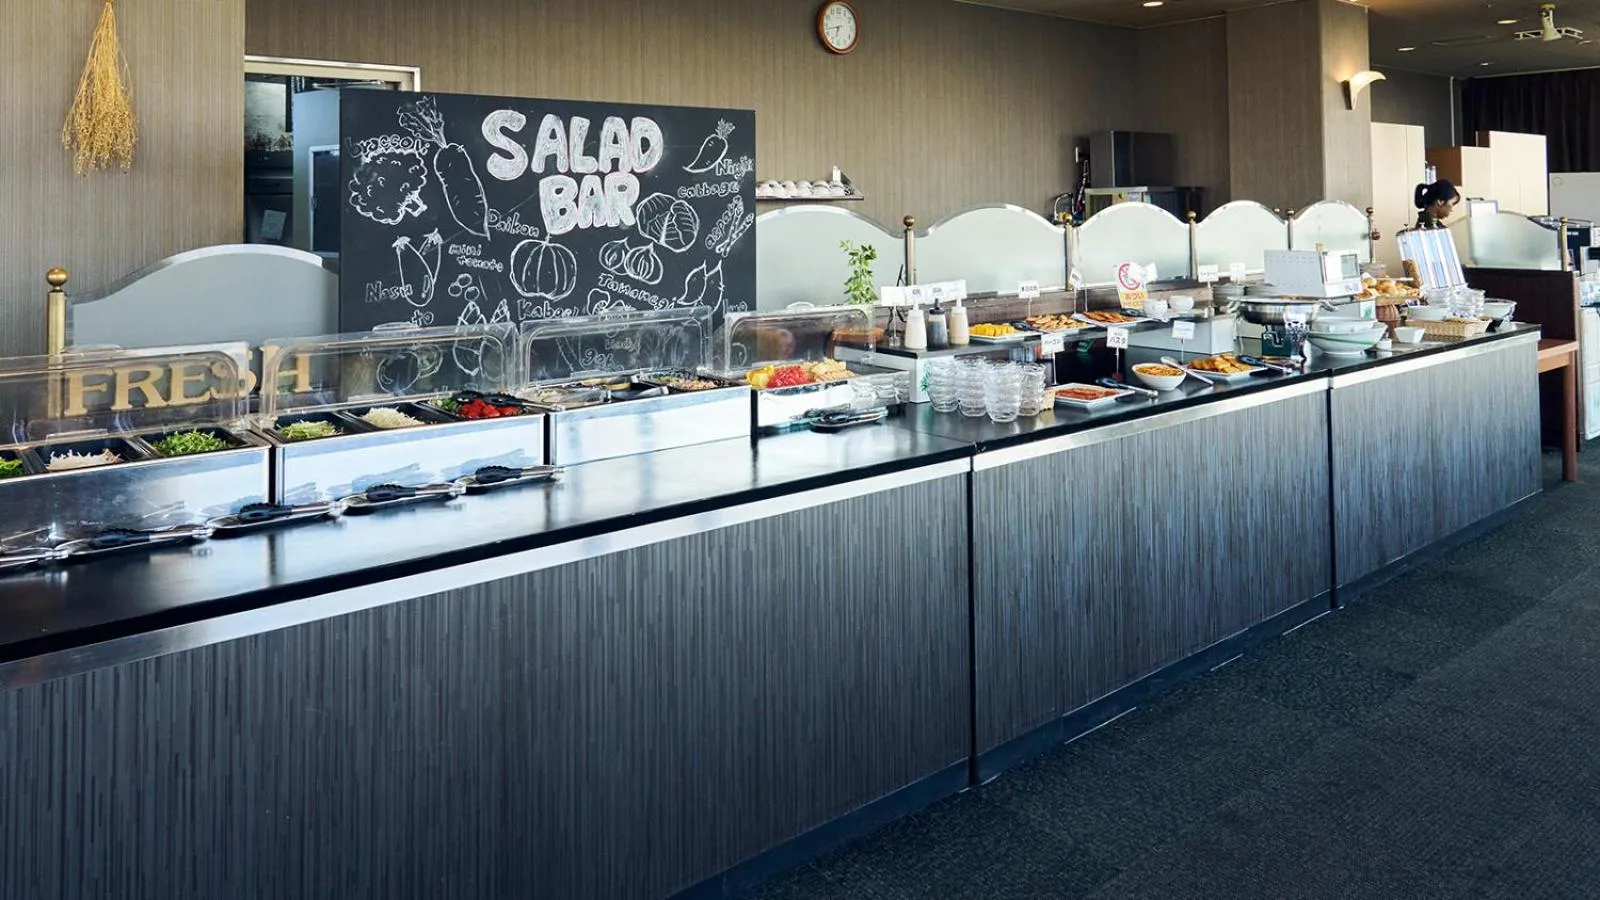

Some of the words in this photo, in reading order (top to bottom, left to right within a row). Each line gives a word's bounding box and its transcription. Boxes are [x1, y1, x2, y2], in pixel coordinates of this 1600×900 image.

[482, 109, 663, 180] SALAD
[539, 171, 641, 235] BAR
[678, 181, 741, 198] cabbage
[487, 208, 540, 238] Daikon
[448, 244, 482, 257] mini
[63, 345, 313, 417] FRESH
